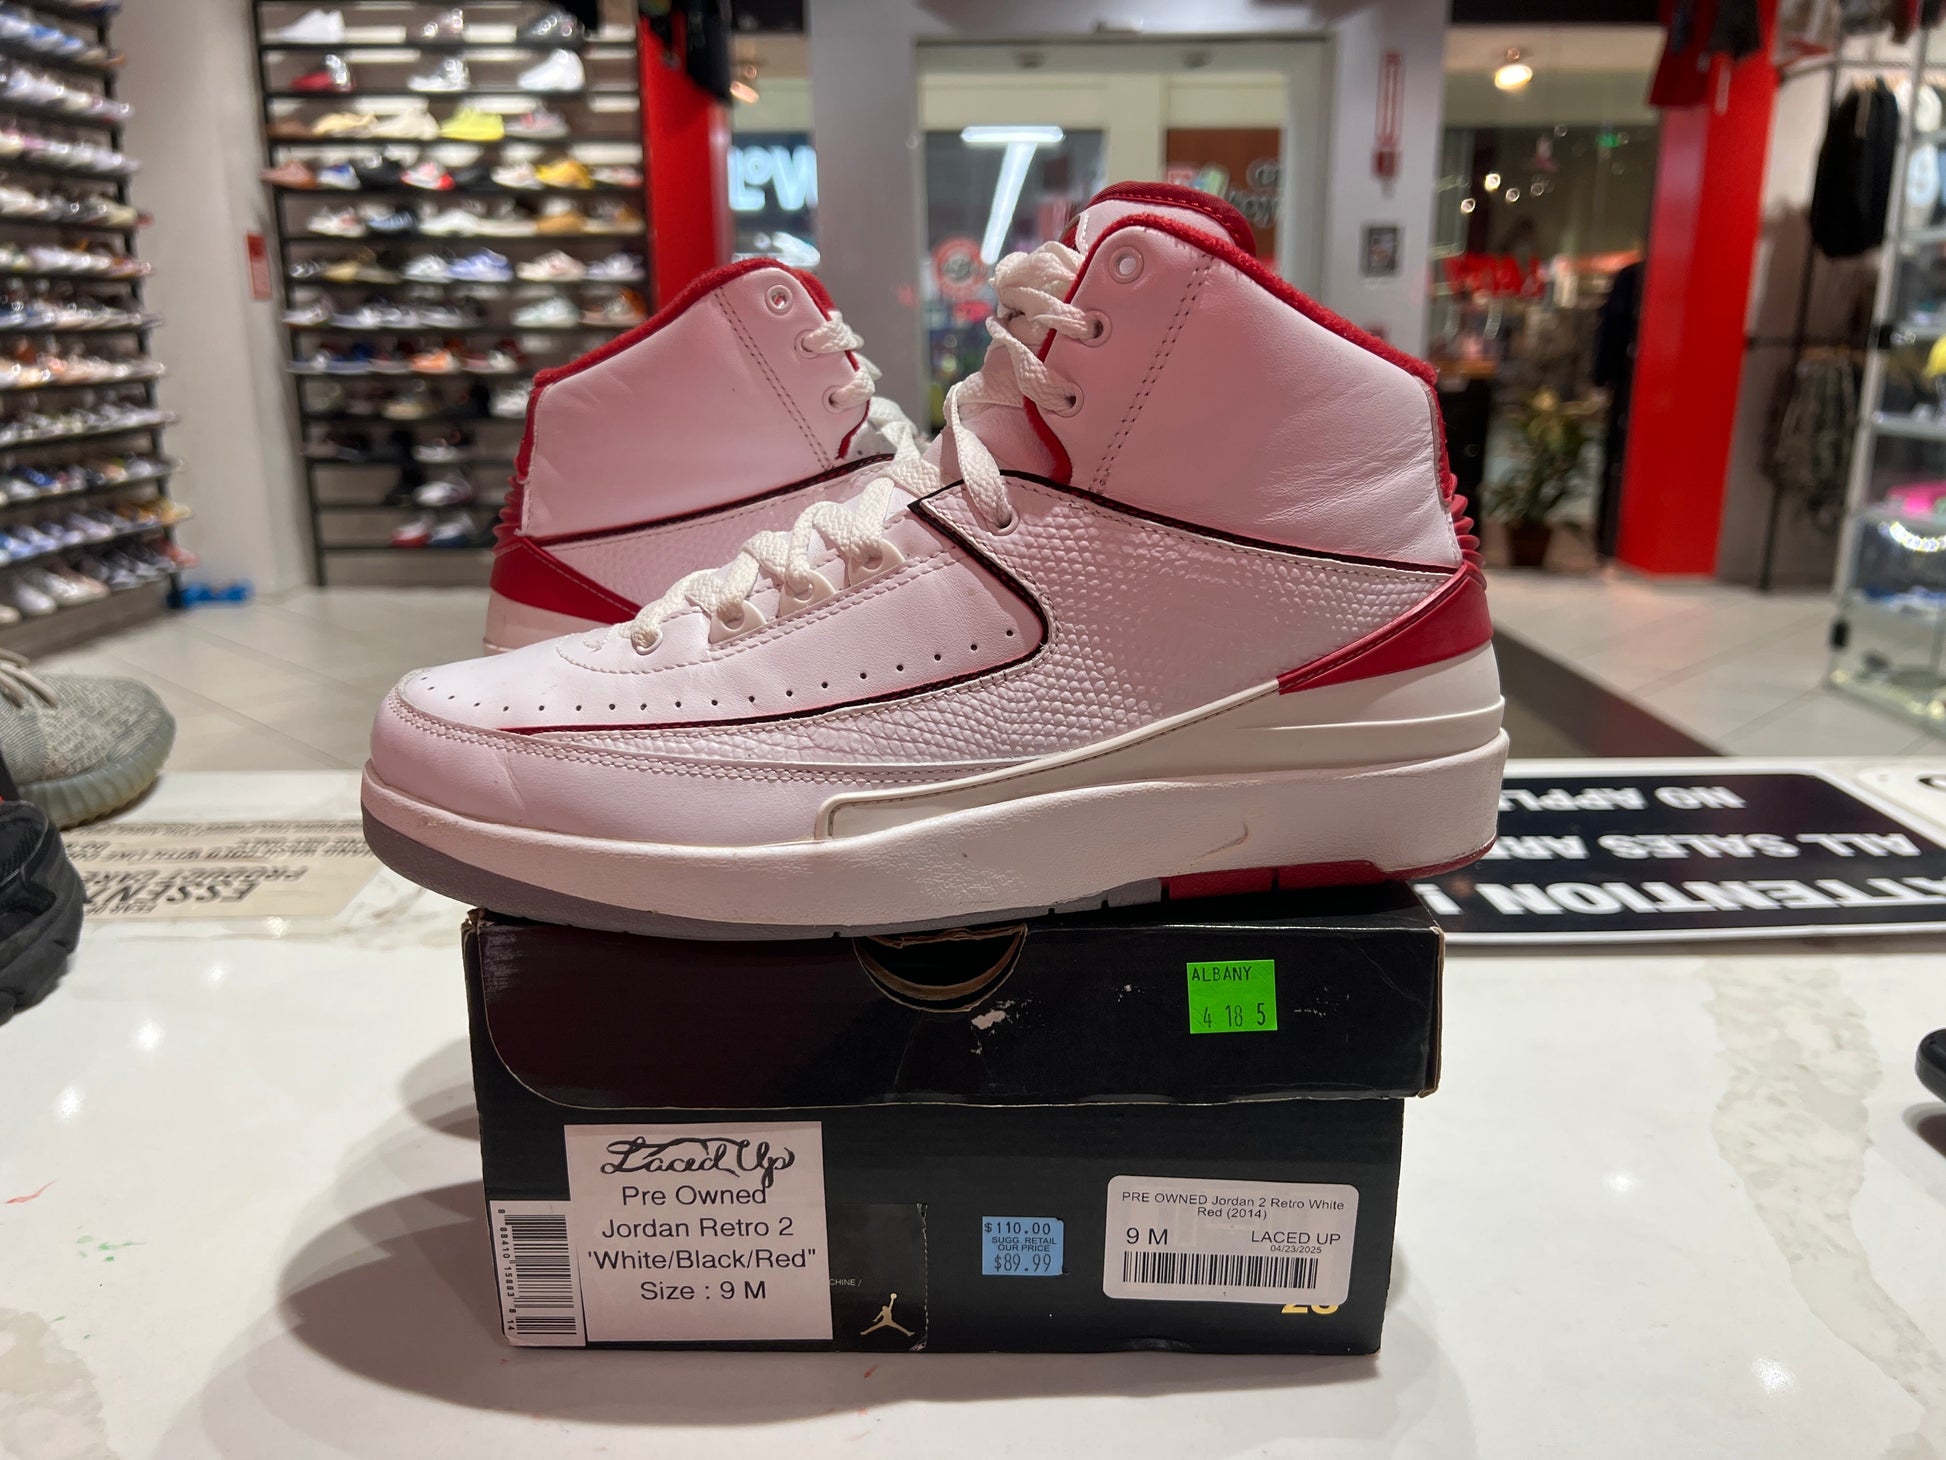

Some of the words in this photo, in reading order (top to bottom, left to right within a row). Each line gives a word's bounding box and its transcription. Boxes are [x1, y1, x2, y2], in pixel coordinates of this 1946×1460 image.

[1655, 786, 1747, 809] NO
[1598, 833, 1801, 859] SALES
[1796, 833, 1922, 857] ALL
[166, 866, 308, 883] PRODUCT
[1192, 966, 1252, 982] ALBANY
[1203, 1007, 1212, 1028] 4
[1225, 1004, 1243, 1027] 18
[1256, 1002, 1266, 1026] 5
[601, 1136, 740, 1177] Laced
[736, 1138, 796, 1189] Up
[622, 1186, 667, 1206] Pre
[675, 1185, 767, 1205] Owned
[1122, 1191, 1150, 1203] PRE
[1154, 1192, 1208, 1205] OWNED
[1211, 1195, 1255, 1207] Jordan
[1258, 1198, 1266, 1208] 2
[1270, 1198, 1305, 1209] Retro
[1308, 1199, 1345, 1211] White
[1197, 1207, 1223, 1218] Red
[1226, 1208, 1268, 1220] (2014)
[602, 1218, 690, 1238] Jordan
[700, 1217, 770, 1237] Retro
[778, 1217, 794, 1236] 2
[984, 1221, 1051, 1235] $110.00
[1126, 1227, 1140, 1245] 9
[1148, 1228, 1169, 1245] M
[1024, 1237, 1057, 1245] RETAIL
[1251, 1230, 1311, 1245] LACED
[1316, 1232, 1341, 1246] UP
[997, 1244, 1019, 1252] OUR
[1021, 1244, 1051, 1252] PRICE
[1270, 1244, 1322, 1254] 04/23/2025
[994, 1253, 1051, 1272] $89.99
[640, 1281, 695, 1300] Size
[720, 1281, 735, 1300] 9
[745, 1281, 766, 1299] M
